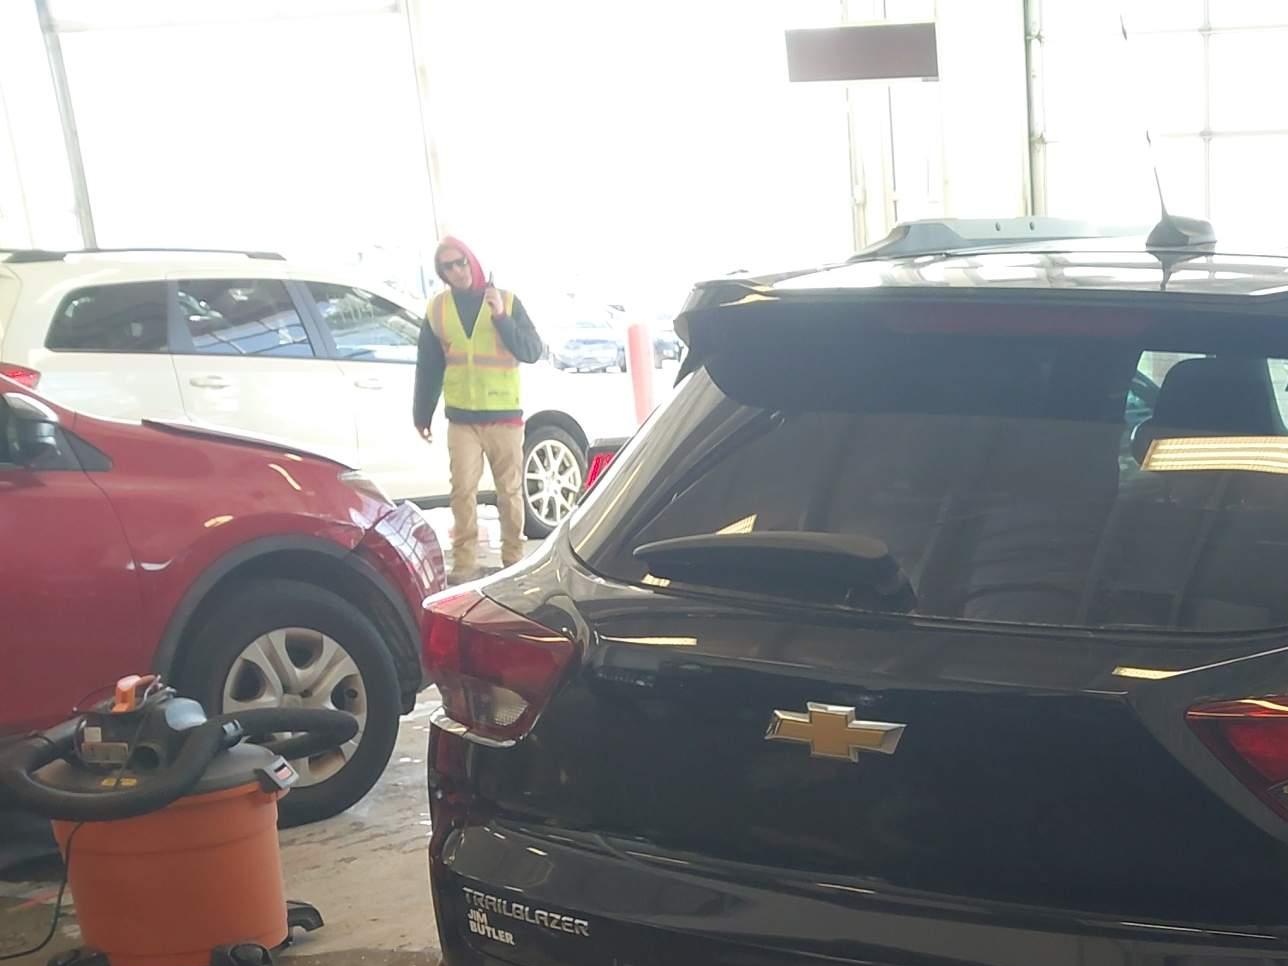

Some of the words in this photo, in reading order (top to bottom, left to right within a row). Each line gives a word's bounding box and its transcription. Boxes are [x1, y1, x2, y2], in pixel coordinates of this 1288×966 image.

[462, 887, 590, 936] TRAILBLAZER
[467, 909, 488, 925] JIM
[469, 921, 515, 945] BUTLER
